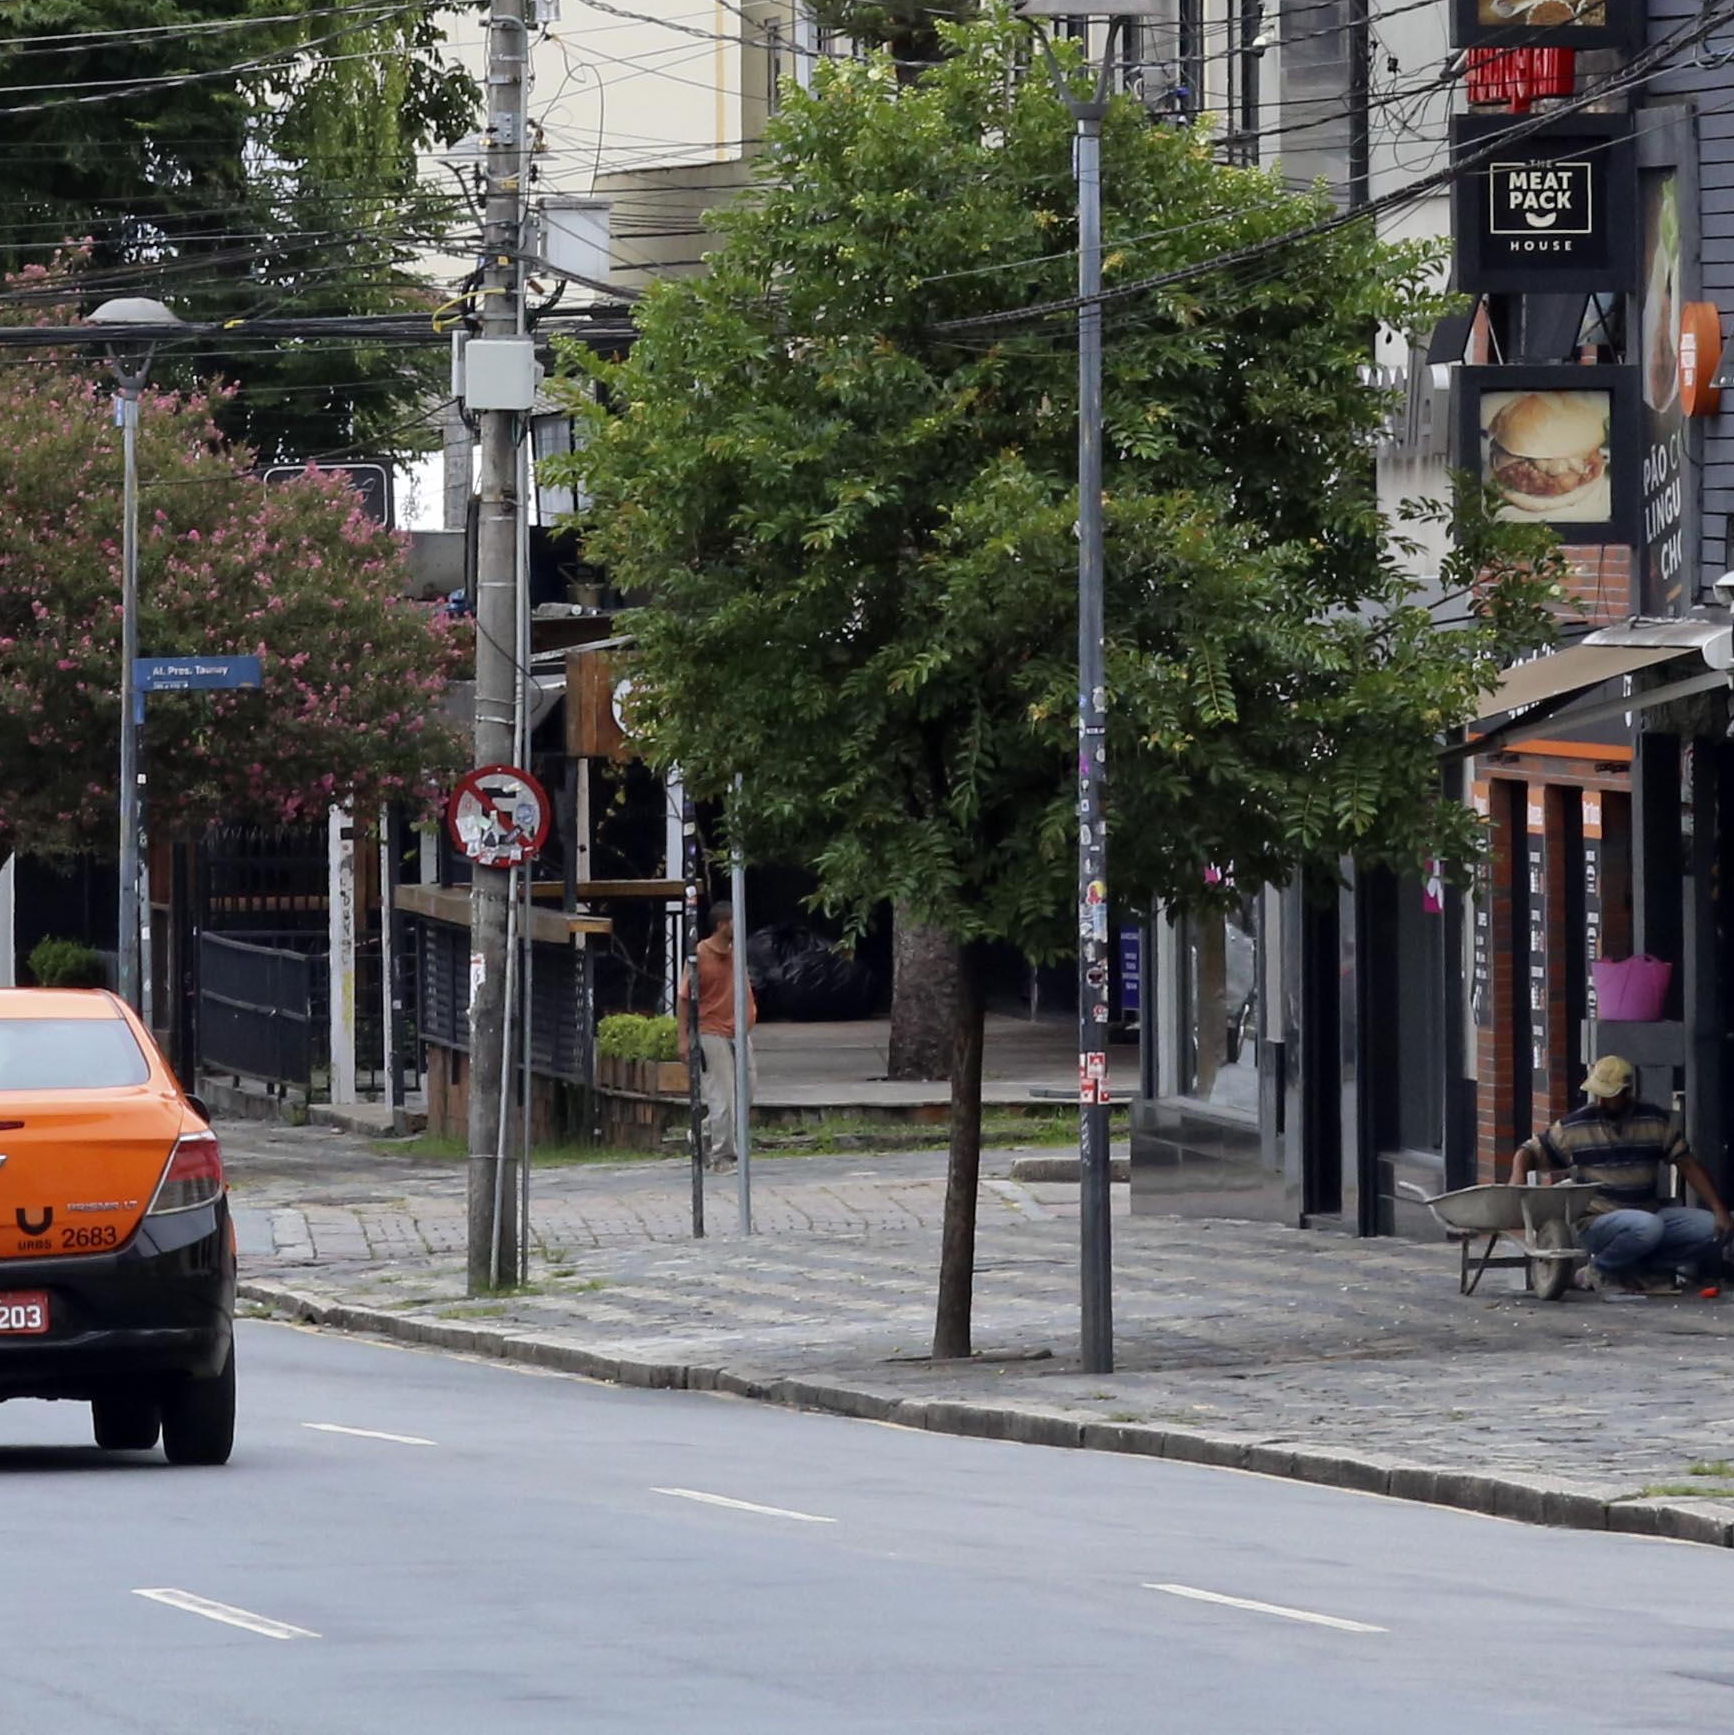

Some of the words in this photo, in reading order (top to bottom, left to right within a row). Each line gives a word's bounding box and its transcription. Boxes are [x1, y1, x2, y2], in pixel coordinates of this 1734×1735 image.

[1529, 159, 1553, 168] THE
[1509, 172, 1573, 190] MEAT
[1509, 191, 1572, 209] PACK
[1510, 241, 1572, 251] HOUSE
[1643, 444, 1667, 496] PÃO
[168, 666, 192, 676] Pres.
[61, 1226, 117, 1248] 2683
[17, 1239, 53, 1251] URBS
